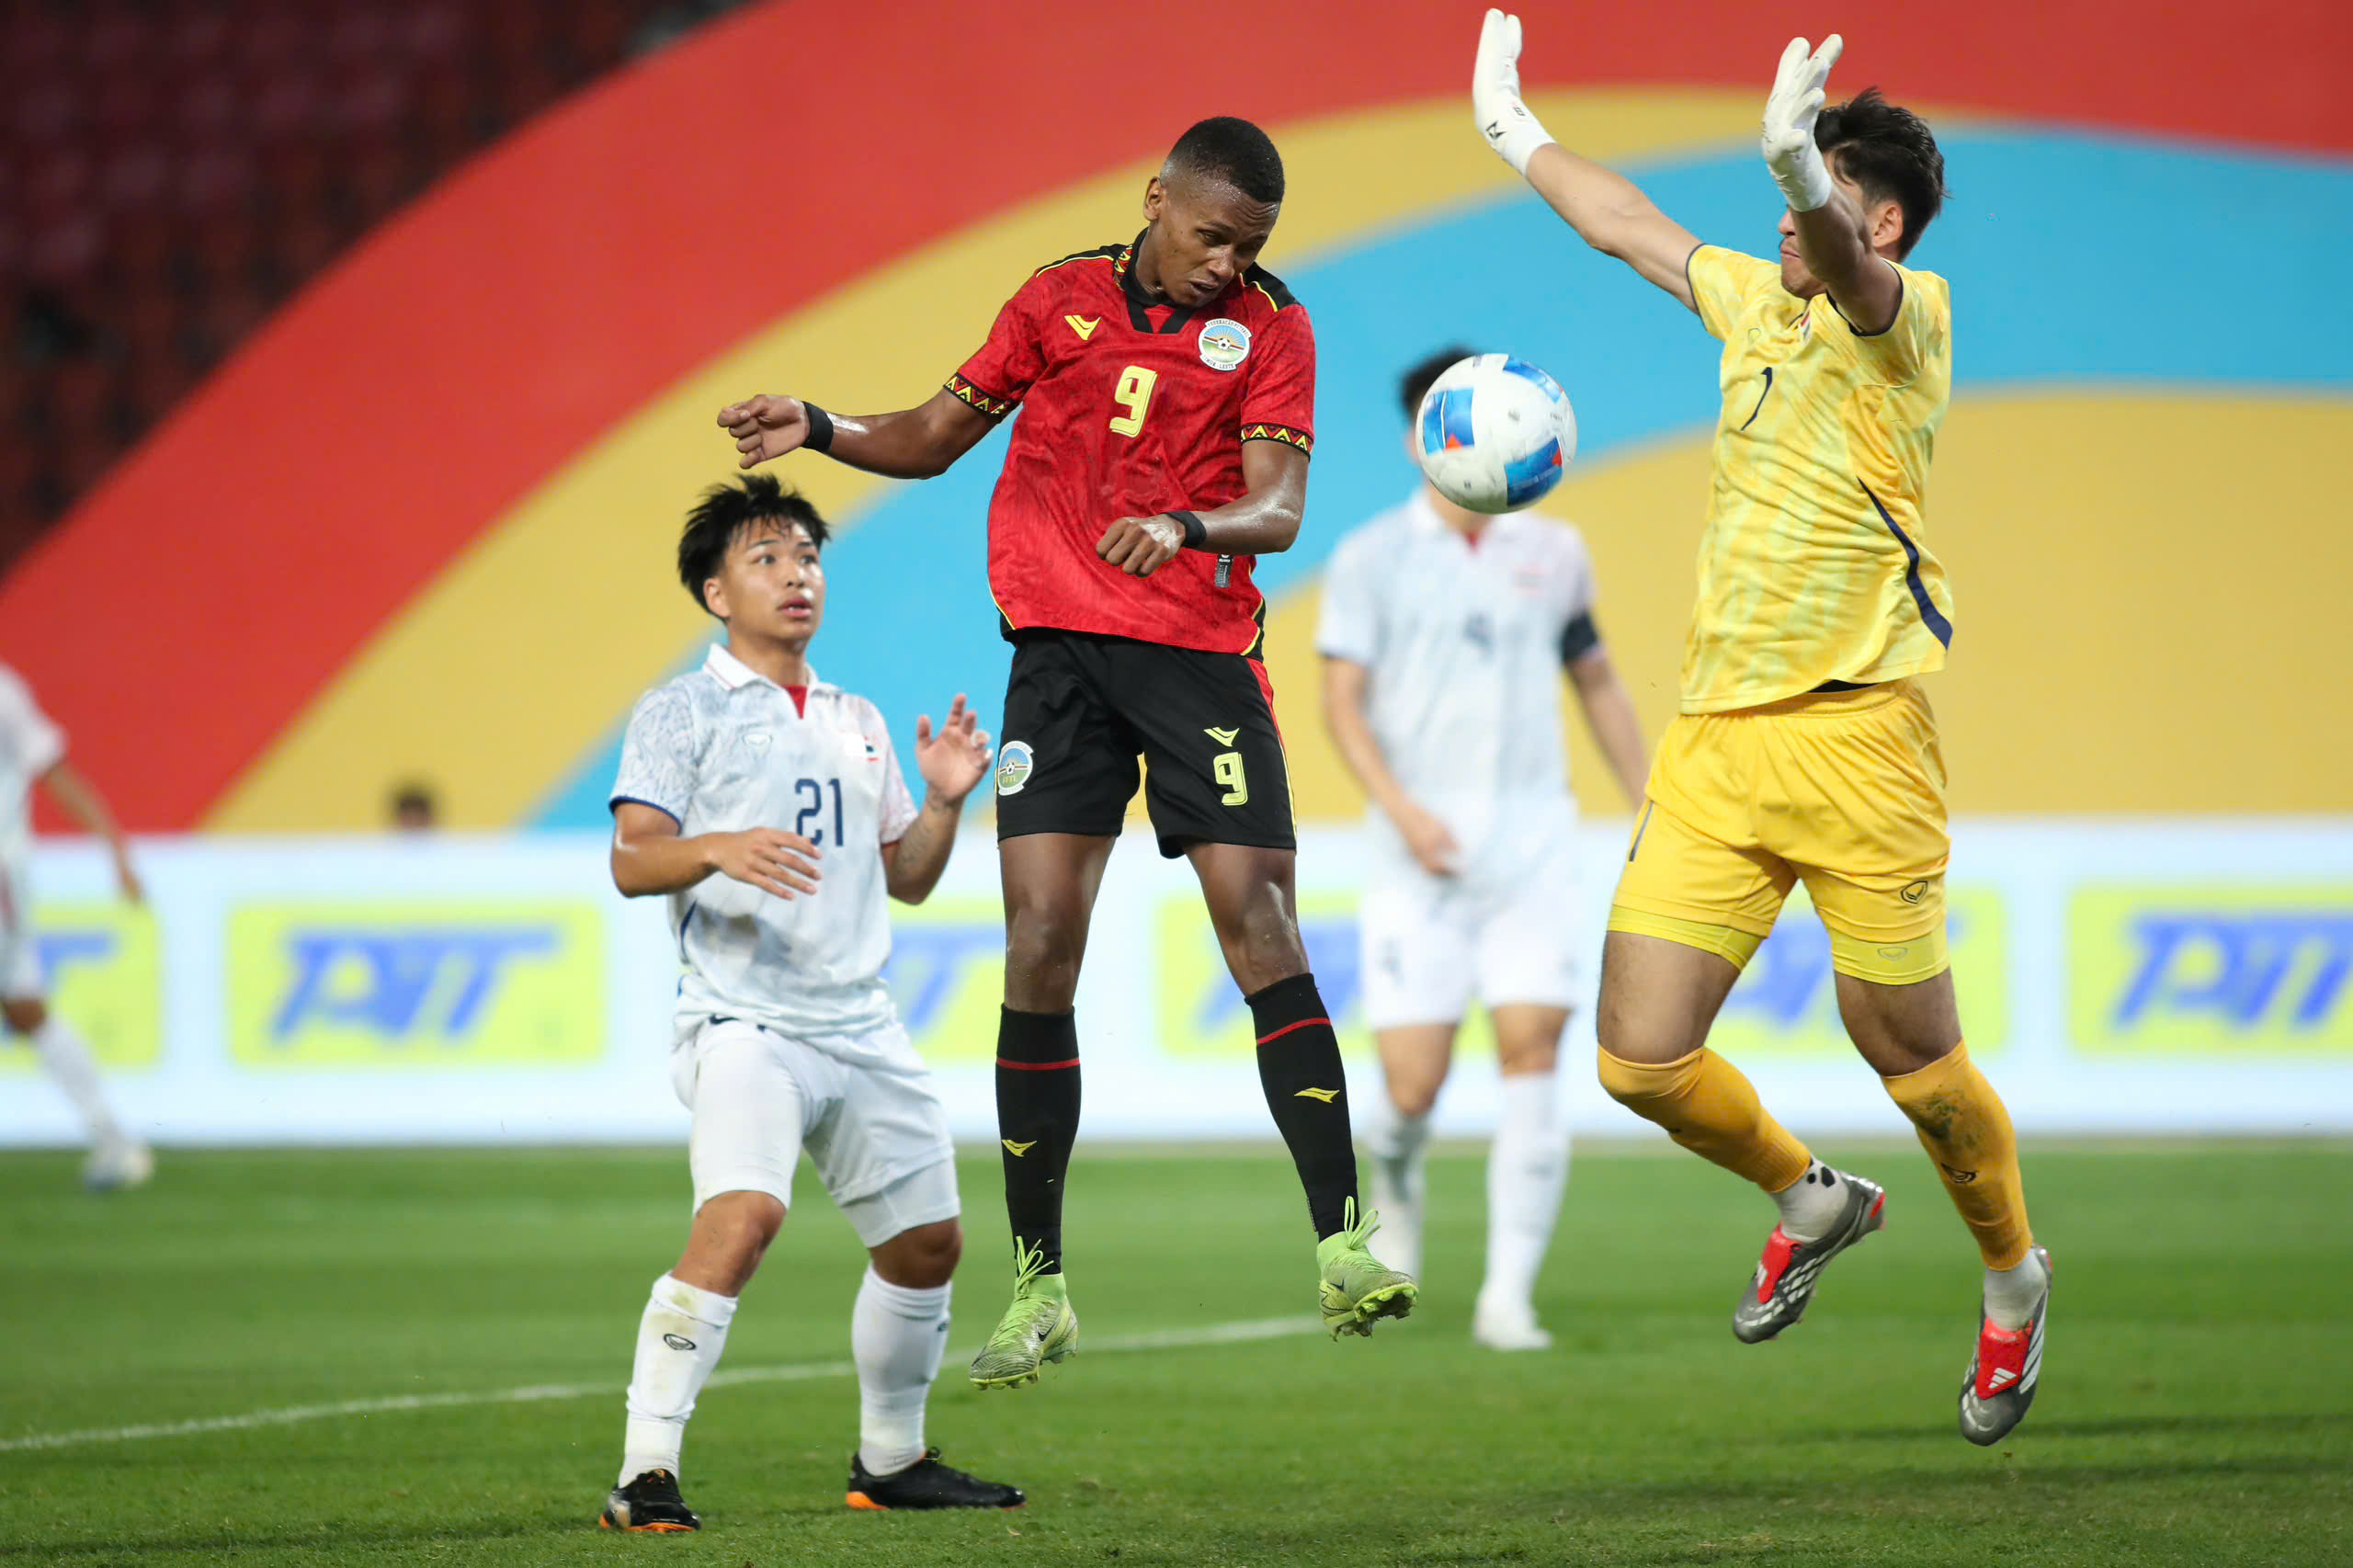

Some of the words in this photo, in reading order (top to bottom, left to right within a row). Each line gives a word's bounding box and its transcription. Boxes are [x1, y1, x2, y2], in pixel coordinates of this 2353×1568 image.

[1109, 365, 1158, 437] 9
[795, 778, 844, 846] 21
[1213, 752, 1248, 806] 9
